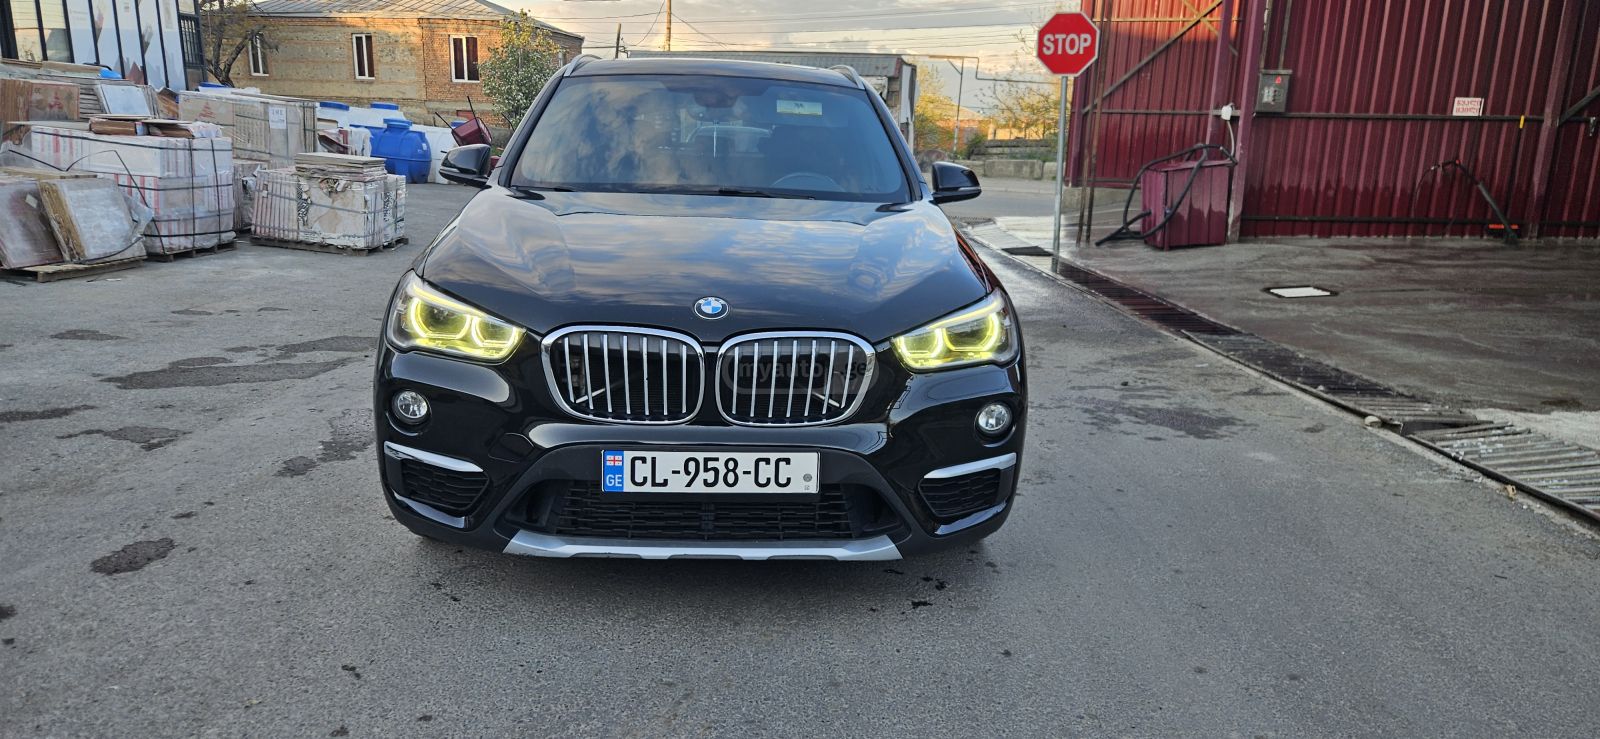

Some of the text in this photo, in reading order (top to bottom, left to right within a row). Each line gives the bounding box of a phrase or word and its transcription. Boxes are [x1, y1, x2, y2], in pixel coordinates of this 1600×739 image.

[1042, 33, 1092, 56] STOP
[606, 474, 623, 487] GE
[630, 455, 792, 489] CL-958-CC
